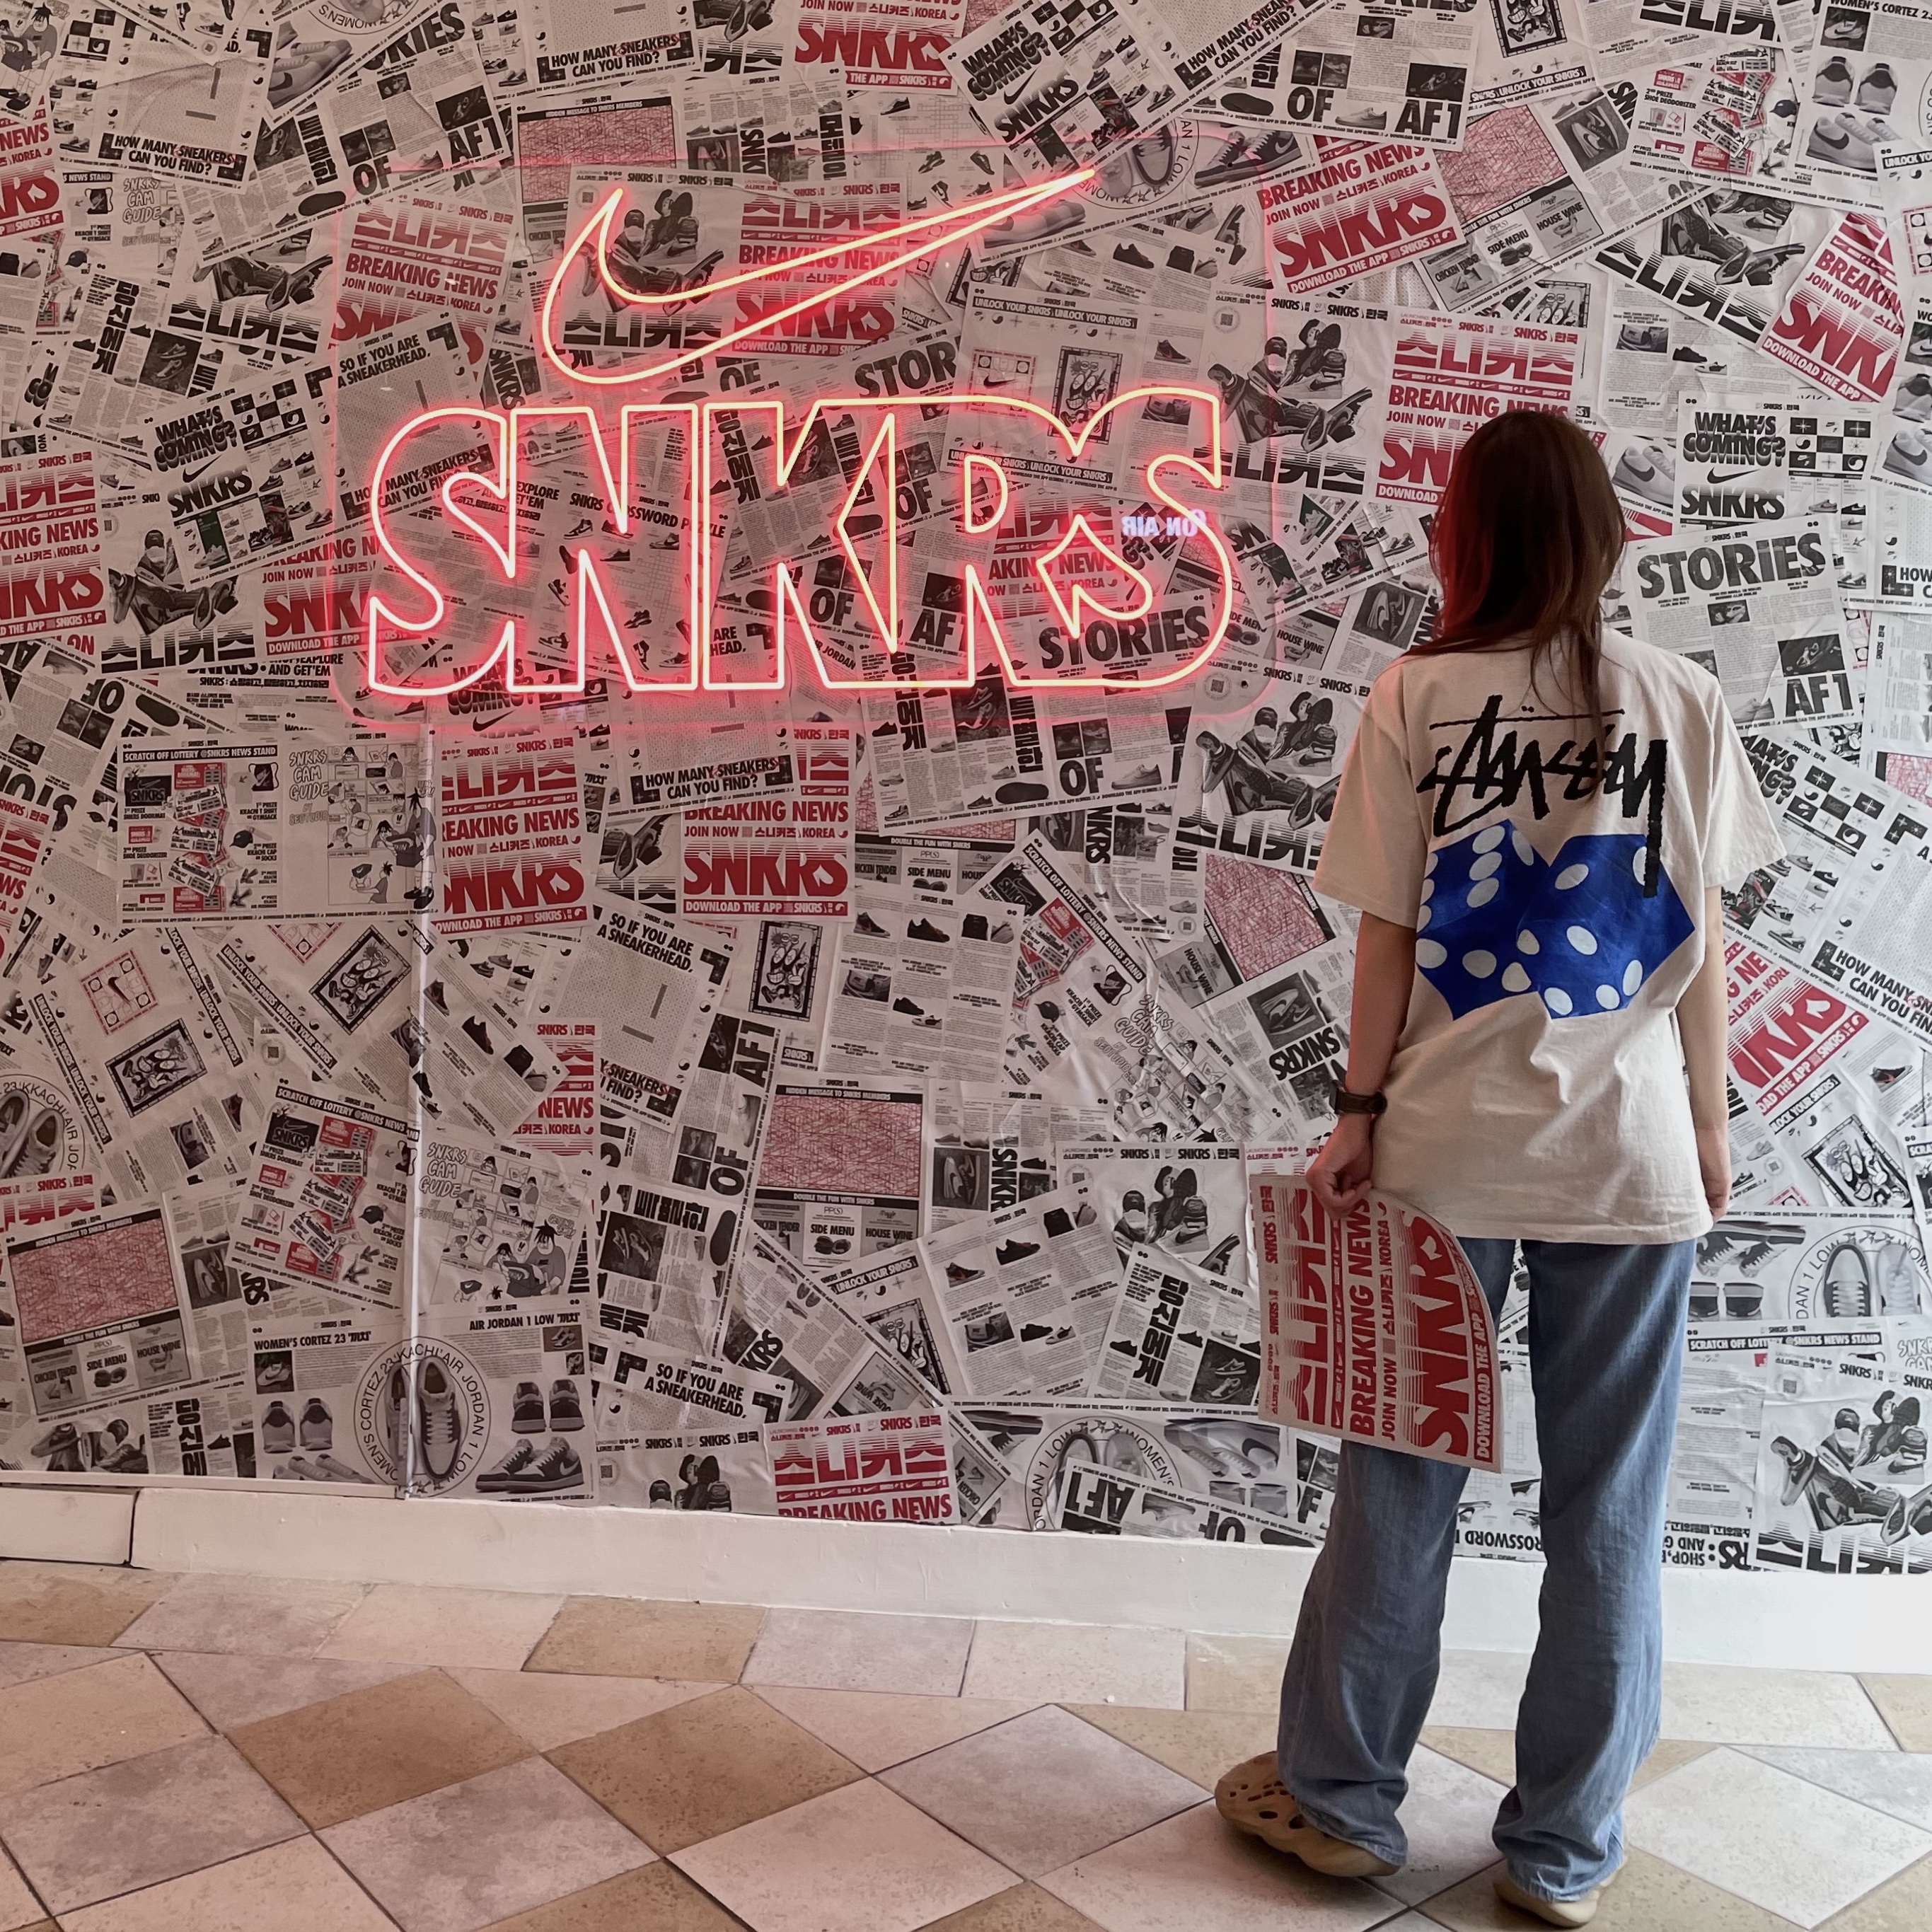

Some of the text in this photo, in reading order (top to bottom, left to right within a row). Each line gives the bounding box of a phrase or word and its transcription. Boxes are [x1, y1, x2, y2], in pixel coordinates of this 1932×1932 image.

[551, 33, 678, 68] HOW MANY SNEAKERS
[794, 16, 953, 71] SNKRS
[961, 21, 1030, 74] WHAT'S
[1188, 21, 1250, 70] HOW MANY
[1214, 5, 1297, 69] CAN YOU FIND?
[572, 52, 660, 77] CAN YOU FIND?
[967, 31, 1051, 101] COMING?
[994, 71, 1080, 143] SNKRS
[1288, 86, 1462, 139] OF AF1
[115, 135, 233, 165] HOW MANY SNEAKERS
[129, 151, 212, 175] CAN YOU FIND?
[353, 155, 392, 195] OF
[448, 117, 502, 165] AF1
[1256, 145, 1426, 210] BREAKING NEWS
[1266, 207, 1290, 225] JOIN
[1293, 197, 1321, 216] NOW
[1383, 166, 1418, 185] KOREA
[1273, 185, 1447, 278] SNKRS
[346, 253, 498, 299] BREAKING NEWS
[1290, 237, 1430, 294] DOWNLOAD THE APP SNKRS
[342, 277, 481, 313] JOIN NOW KOREA
[975, 299, 1051, 316] UNLOCK YOUR SNKRS
[1271, 299, 1300, 311] SNKRS
[1327, 305, 1359, 318] SNKRS
[734, 287, 895, 340] SNKRS
[340, 335, 420, 374] SO IF YOU ARE
[734, 341, 789, 352] DOWNLOAD
[1764, 340, 1820, 378] DOWNLOAD
[338, 376, 347, 389] A
[1389, 385, 1499, 417] BREAKING
[154, 406, 223, 443] WHAT'S
[1387, 411, 1446, 429] JOIN NOW
[1695, 411, 1776, 436] WHAT'S
[154, 421, 238, 473] COMING?
[1683, 432, 1786, 467] COMING?
[168, 464, 253, 518] SNKRS
[516, 481, 560, 499] EXPLORE
[1379, 486, 1438, 502] DOWNLOAD
[1681, 484, 1786, 520] SNKRS
[47, 519, 99, 544] NEWS
[368, 386, 1234, 692] SNKRS
[57, 544, 88, 557] KOREA
[1638, 533, 1825, 598] STORIES
[810, 587, 854, 625] OF
[1039, 606, 1210, 669] STORIES
[1276, 630, 1325, 655] HOUSE WINE
[269, 663, 331, 676] AND GET'EM
[1263, 667, 1352, 694] SNKRS SNKRS
[1786, 673, 1853, 717] AF1
[125, 751, 155, 762] SCRATCH
[156, 750, 169, 760] OFF
[170, 749, 199, 760] LOTTERY
[231, 747, 250, 758] NEWS
[253, 746, 277, 757] STAND
[294, 766, 322, 782] CAM
[646, 758, 775, 787] HOW MANY SNEAKERS
[667, 775, 758, 799] CAN YOU FIND?
[1060, 757, 1104, 797] OF
[289, 781, 330, 800] GUIDE
[524, 808, 579, 836] NEWS
[684, 801, 848, 822] BREAKING NEWS
[684, 826, 708, 838] JOIN
[712, 826, 739, 838] NOW
[802, 828, 835, 838] KOREA
[683, 842, 848, 897] SNKRS
[908, 867, 951, 879] SIDE MENU
[686, 901, 822, 913] DOWNLOAD THE APP SNKRS
[597, 925, 606, 937] A
[610, 913, 694, 956] SO IF YOU ARE
[1836, 949, 1914, 998] HOW MANY
[1850, 977, 1909, 1018] CAN YOU
[1269, 1027, 1341, 1081] SNKRS
[1120, 1148, 1210, 1160] SNKRS SNKRS
[1379, 1221, 1392, 1266] KOREA
[470, 1319, 485, 1331] AIR
[487, 1317, 524, 1329] JORDAN
[535, 1314, 554, 1325] LOW
[1343, 1198, 1376, 1436] BREAKING NEWS
[1401, 1209, 1469, 1457] SNKRS
[254, 1333, 345, 1350] WOMEN'S CORTEZ 23
[644, 1375, 654, 1391] A
[656, 1363, 745, 1403] SO IF YOU ARE
[1382, 1358, 1397, 1392] NOW
[1470, 1312, 1491, 1458] DOWNLOAD THE APP
[1839, 1363, 1871, 1379] SNKRS
[462, 1373, 485, 1436] JORDAN
[1382, 1397, 1396, 1441] JOIN
[880, 1418, 913, 1431] SNKRS
[891, 1494, 953, 1520] NEWS
[1464, 1529, 1544, 1551] ROSSWORD
